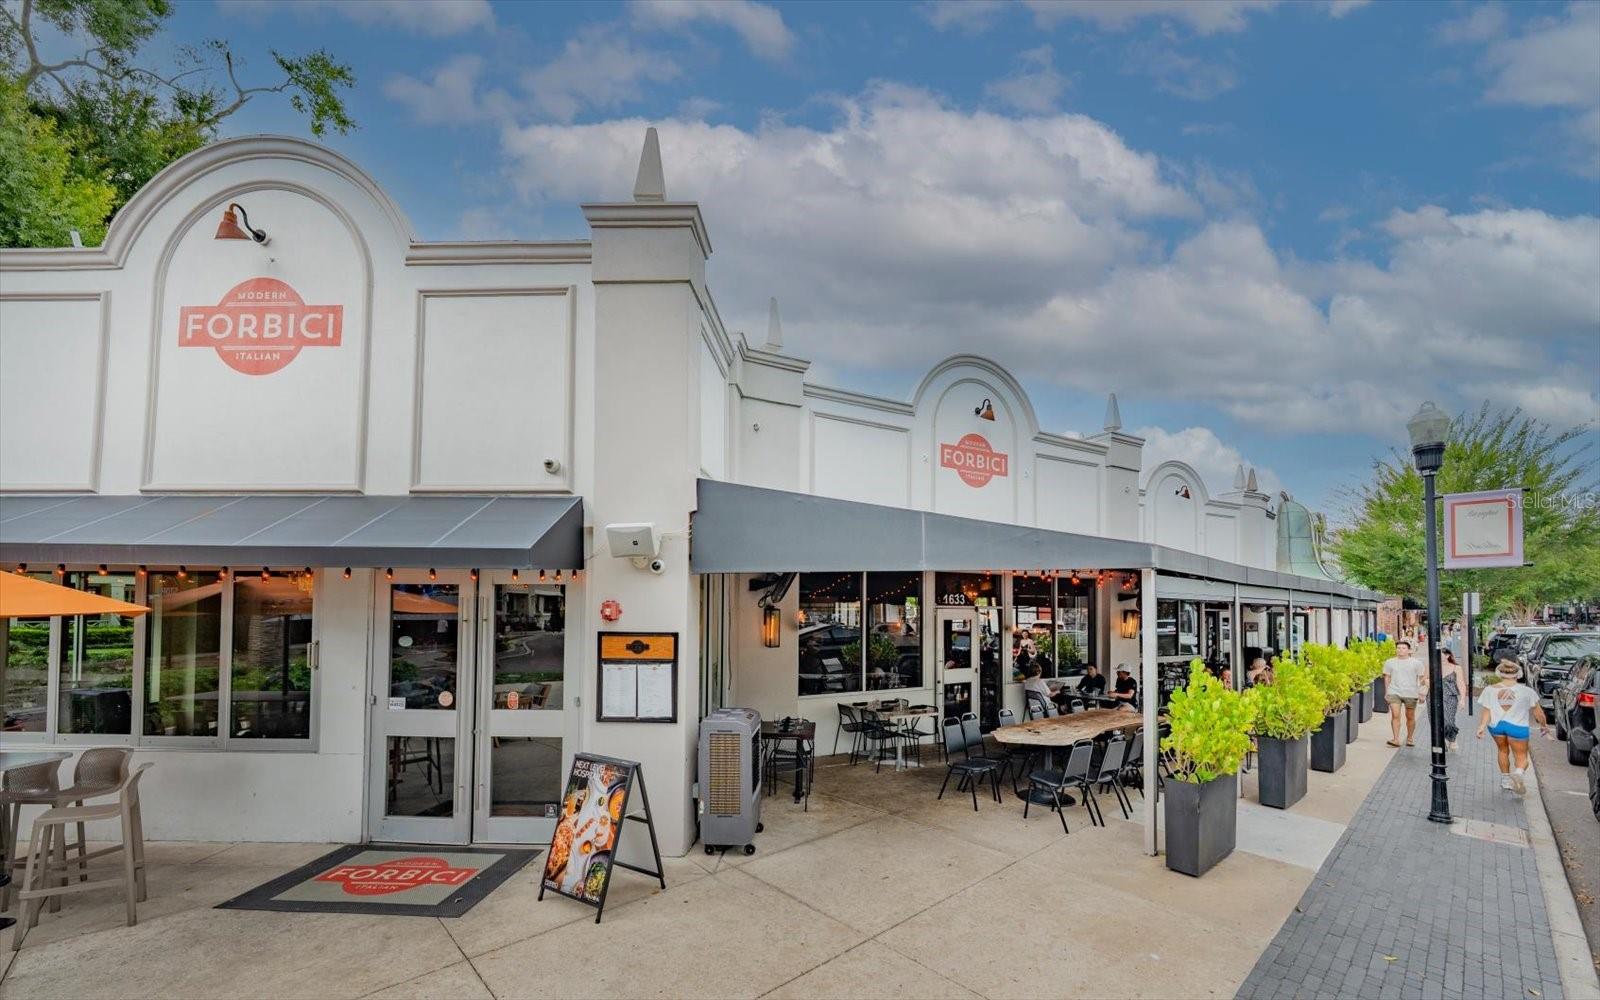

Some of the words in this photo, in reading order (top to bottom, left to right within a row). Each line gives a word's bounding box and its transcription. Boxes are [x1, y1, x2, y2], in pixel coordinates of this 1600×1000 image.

[238, 291, 287, 300] MODERN
[186, 313, 335, 339] FORBICI
[235, 352, 281, 361] ITALIAN
[944, 449, 1005, 473] FORBICI
[943, 593, 966, 605] 1633
[575, 760, 590, 770] NEXT
[327, 868, 468, 882] FORBICI
